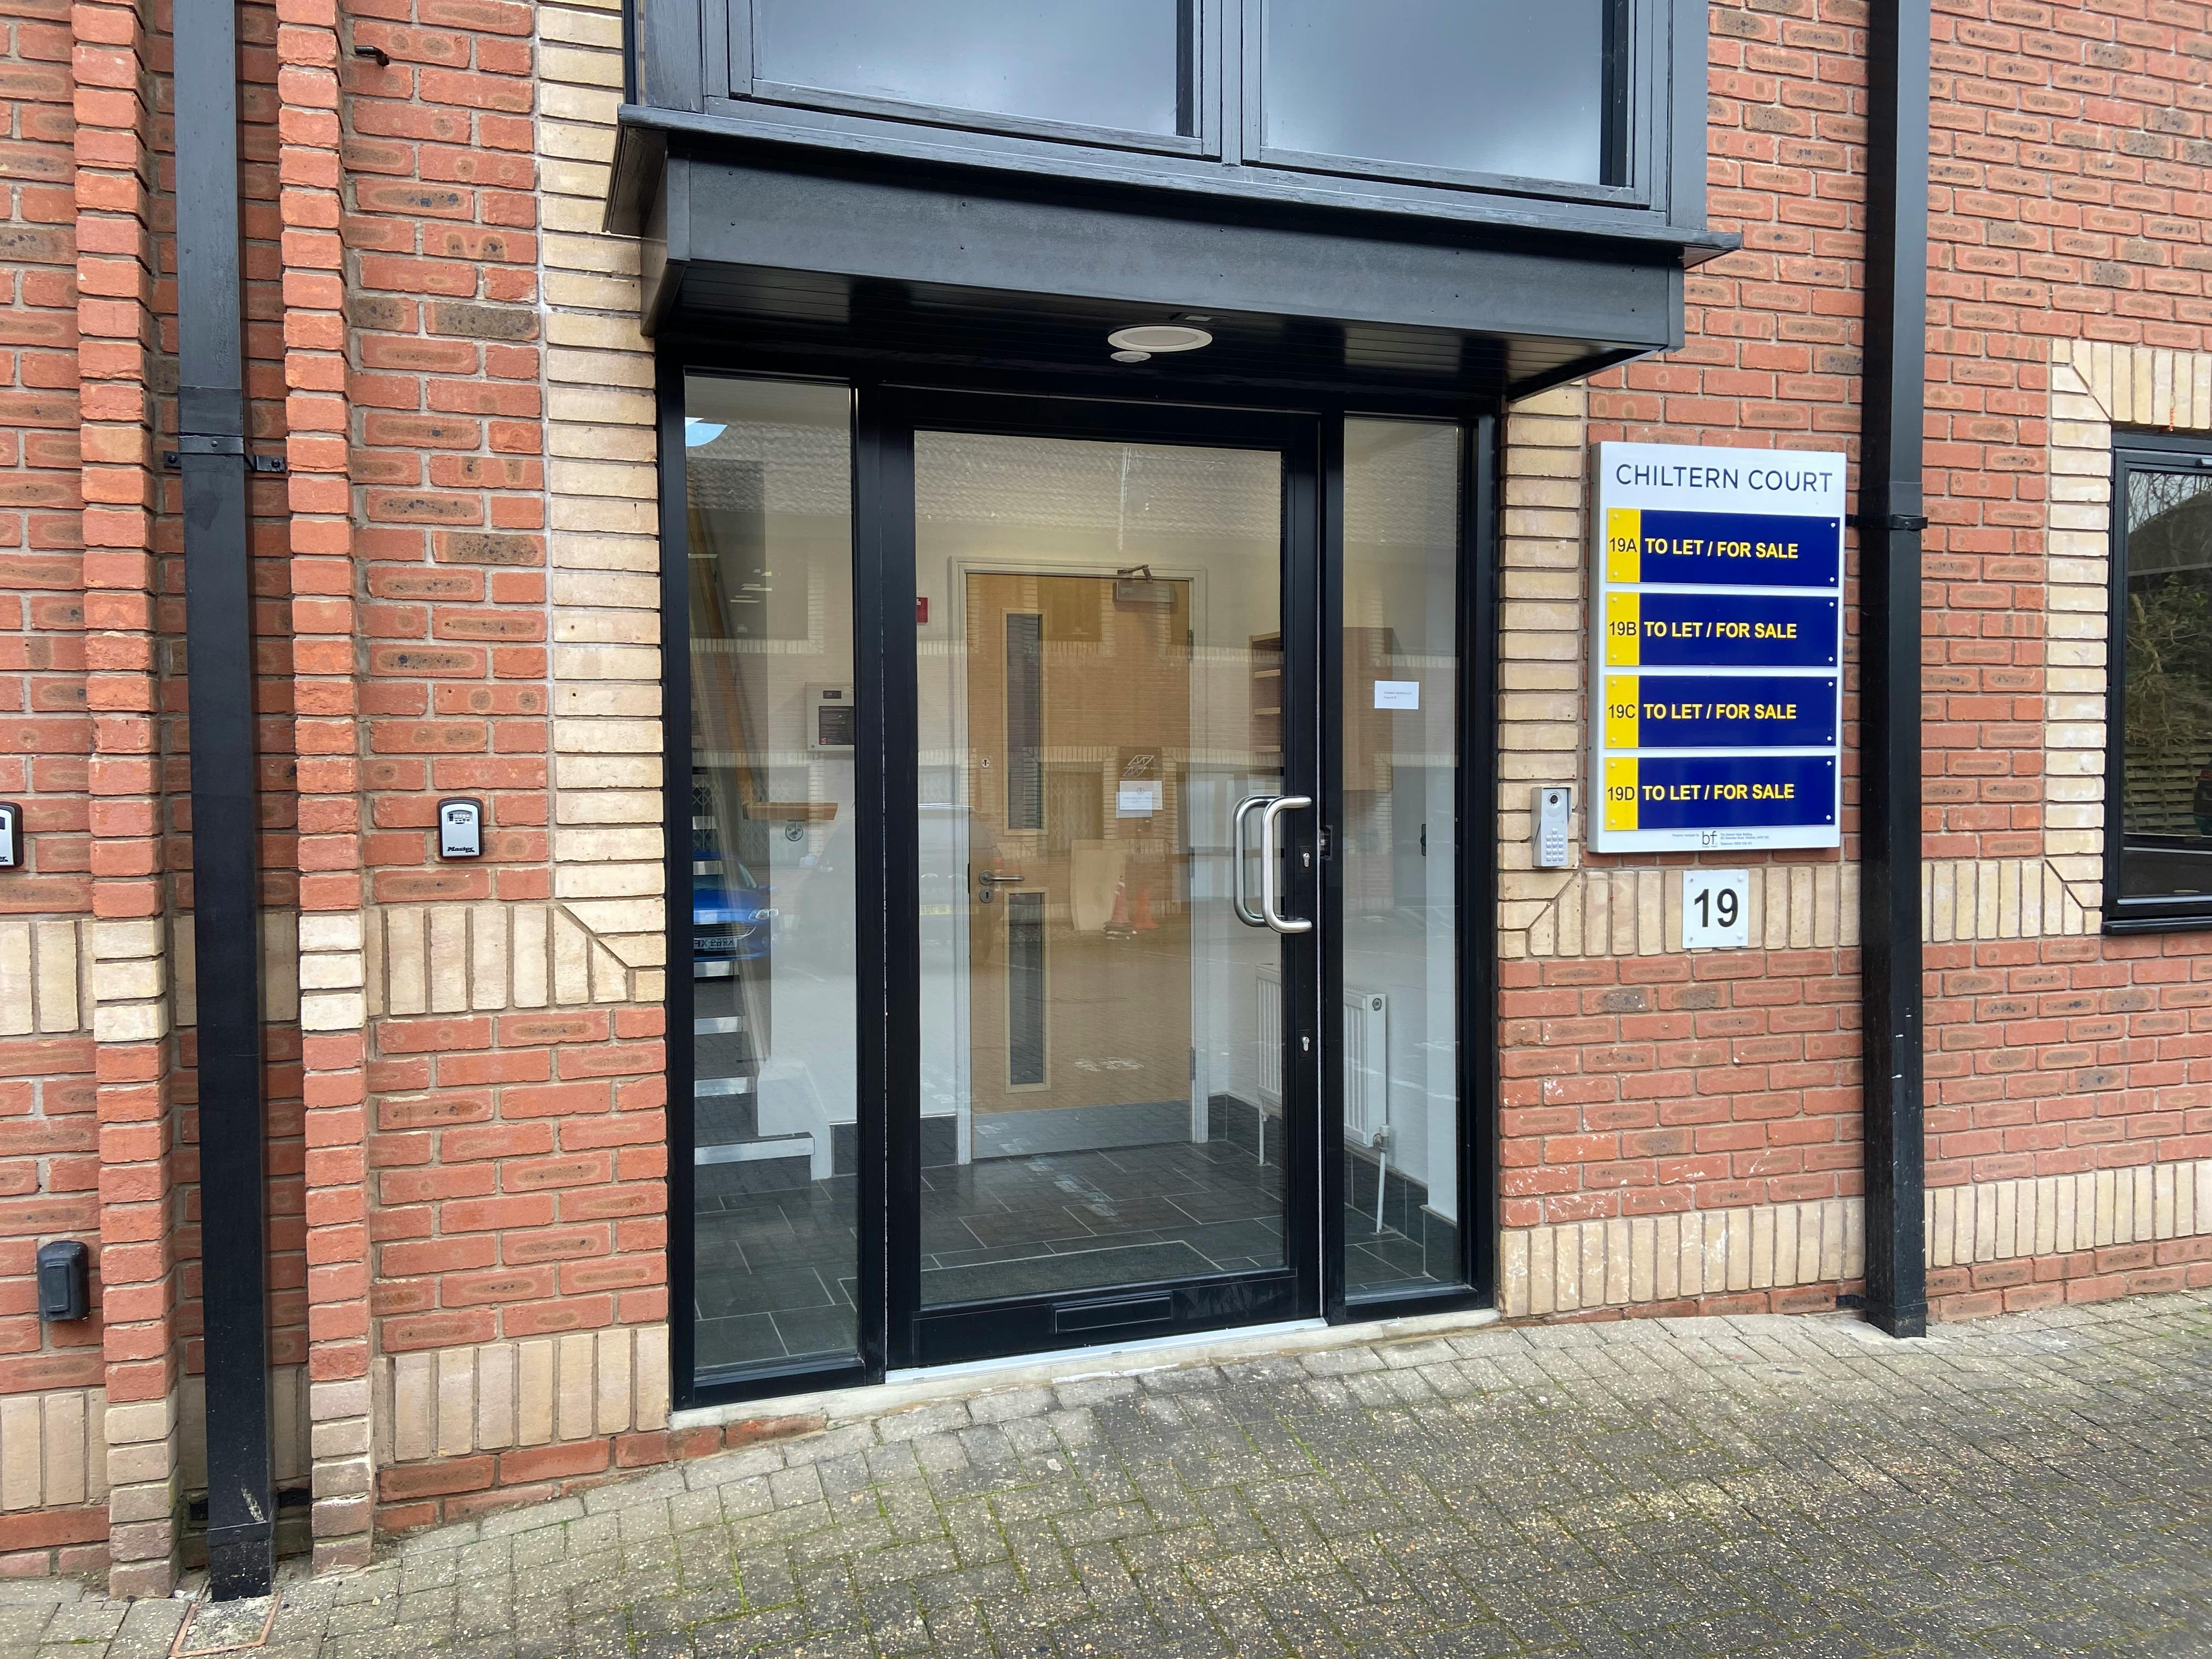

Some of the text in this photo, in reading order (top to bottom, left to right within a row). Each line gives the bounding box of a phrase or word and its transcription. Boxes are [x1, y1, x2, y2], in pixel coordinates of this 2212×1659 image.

[1616, 464, 1833, 492] CHILTERN COURT
[1609, 537, 1638, 553] 19A
[1645, 538, 1798, 558] TO LET / FOR SALE
[1609, 621, 1637, 636] 19B
[1644, 621, 1797, 639] TO LET / FOR SALE
[1608, 704, 1635, 719] 19C
[1643, 703, 1796, 719] TO LET / FOR SALE
[1607, 786, 1635, 801] 19D
[1641, 783, 1794, 801] TO LET / FOR SALE
[1702, 831, 1718, 845] bf
[1694, 888, 1739, 928] 19
